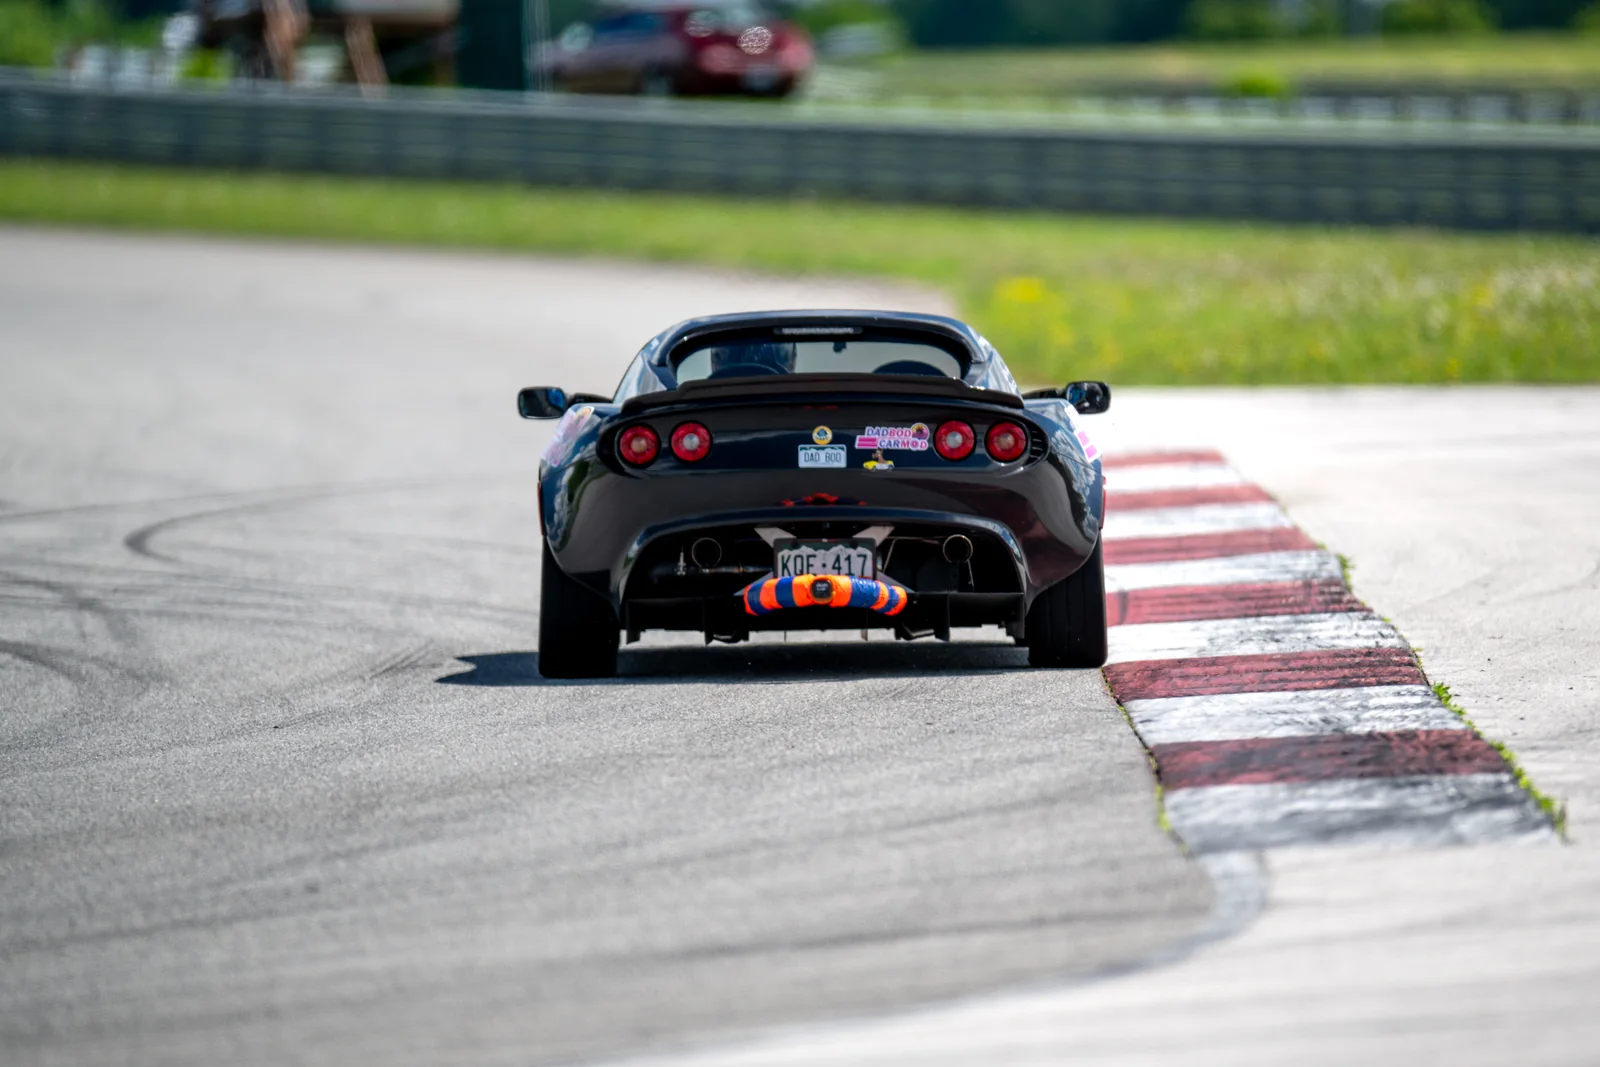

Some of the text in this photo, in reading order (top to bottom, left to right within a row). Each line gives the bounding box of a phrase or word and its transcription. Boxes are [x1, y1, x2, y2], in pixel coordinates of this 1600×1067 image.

[866, 427, 912, 437] DADBOD
[879, 439, 928, 449] CARMOD
[804, 452, 820, 462] DAD
